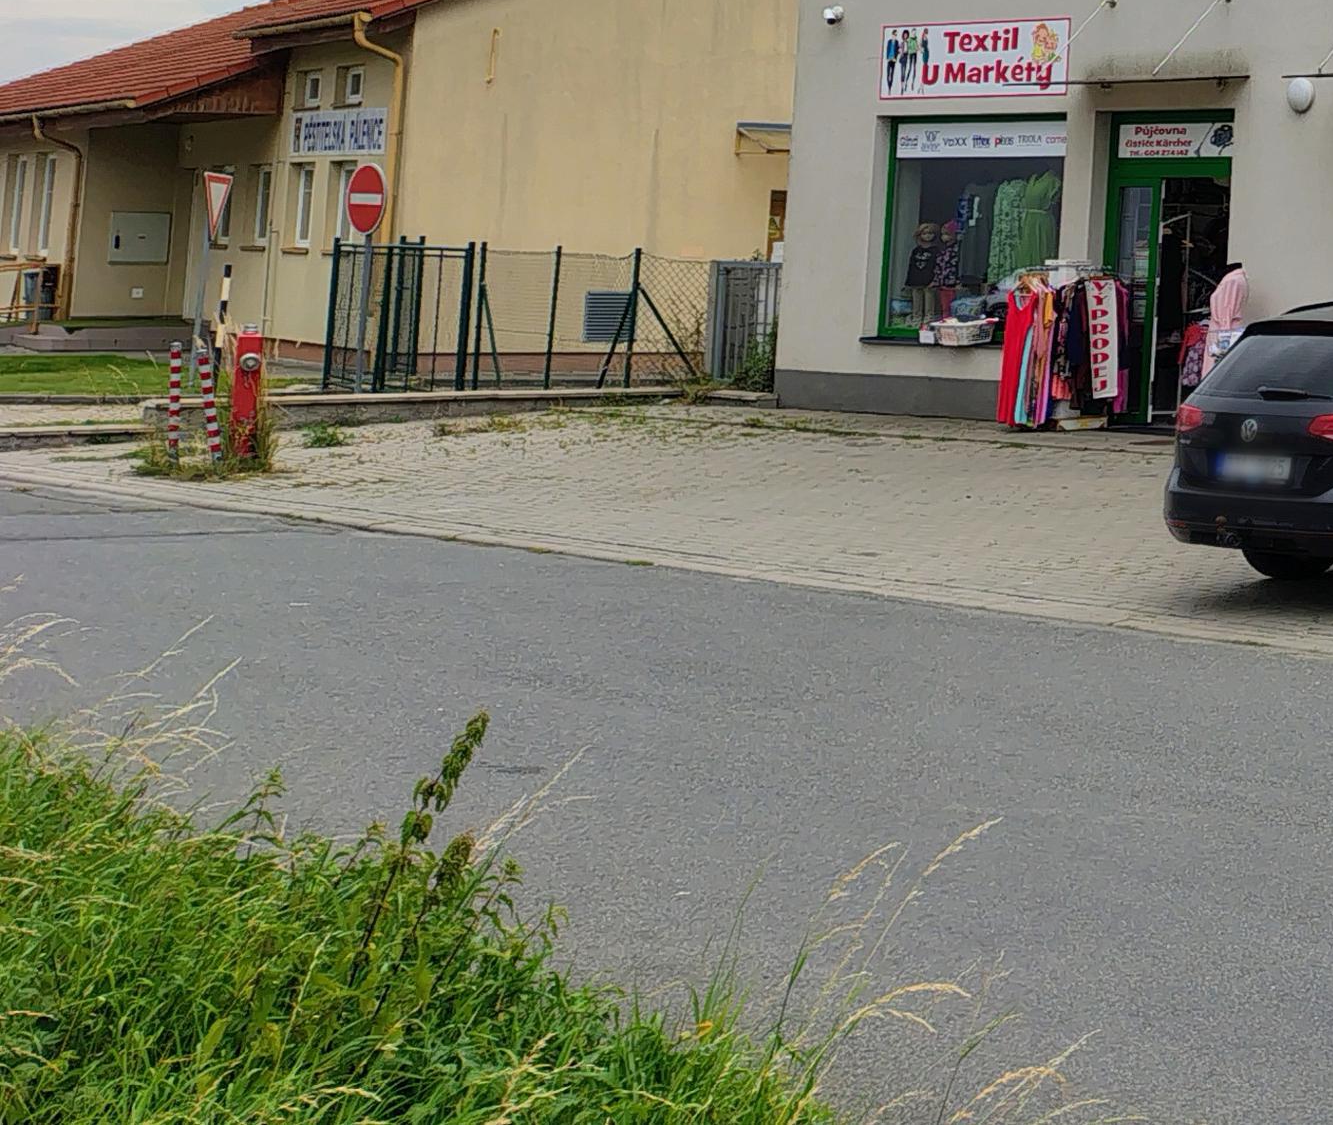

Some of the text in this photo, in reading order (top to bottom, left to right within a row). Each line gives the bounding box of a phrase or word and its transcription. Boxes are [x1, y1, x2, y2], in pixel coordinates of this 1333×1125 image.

[943, 27, 1019, 54] Textil
[922, 56, 1053, 90] U Markéty
[1134, 125, 1187, 139] Půjčovna
